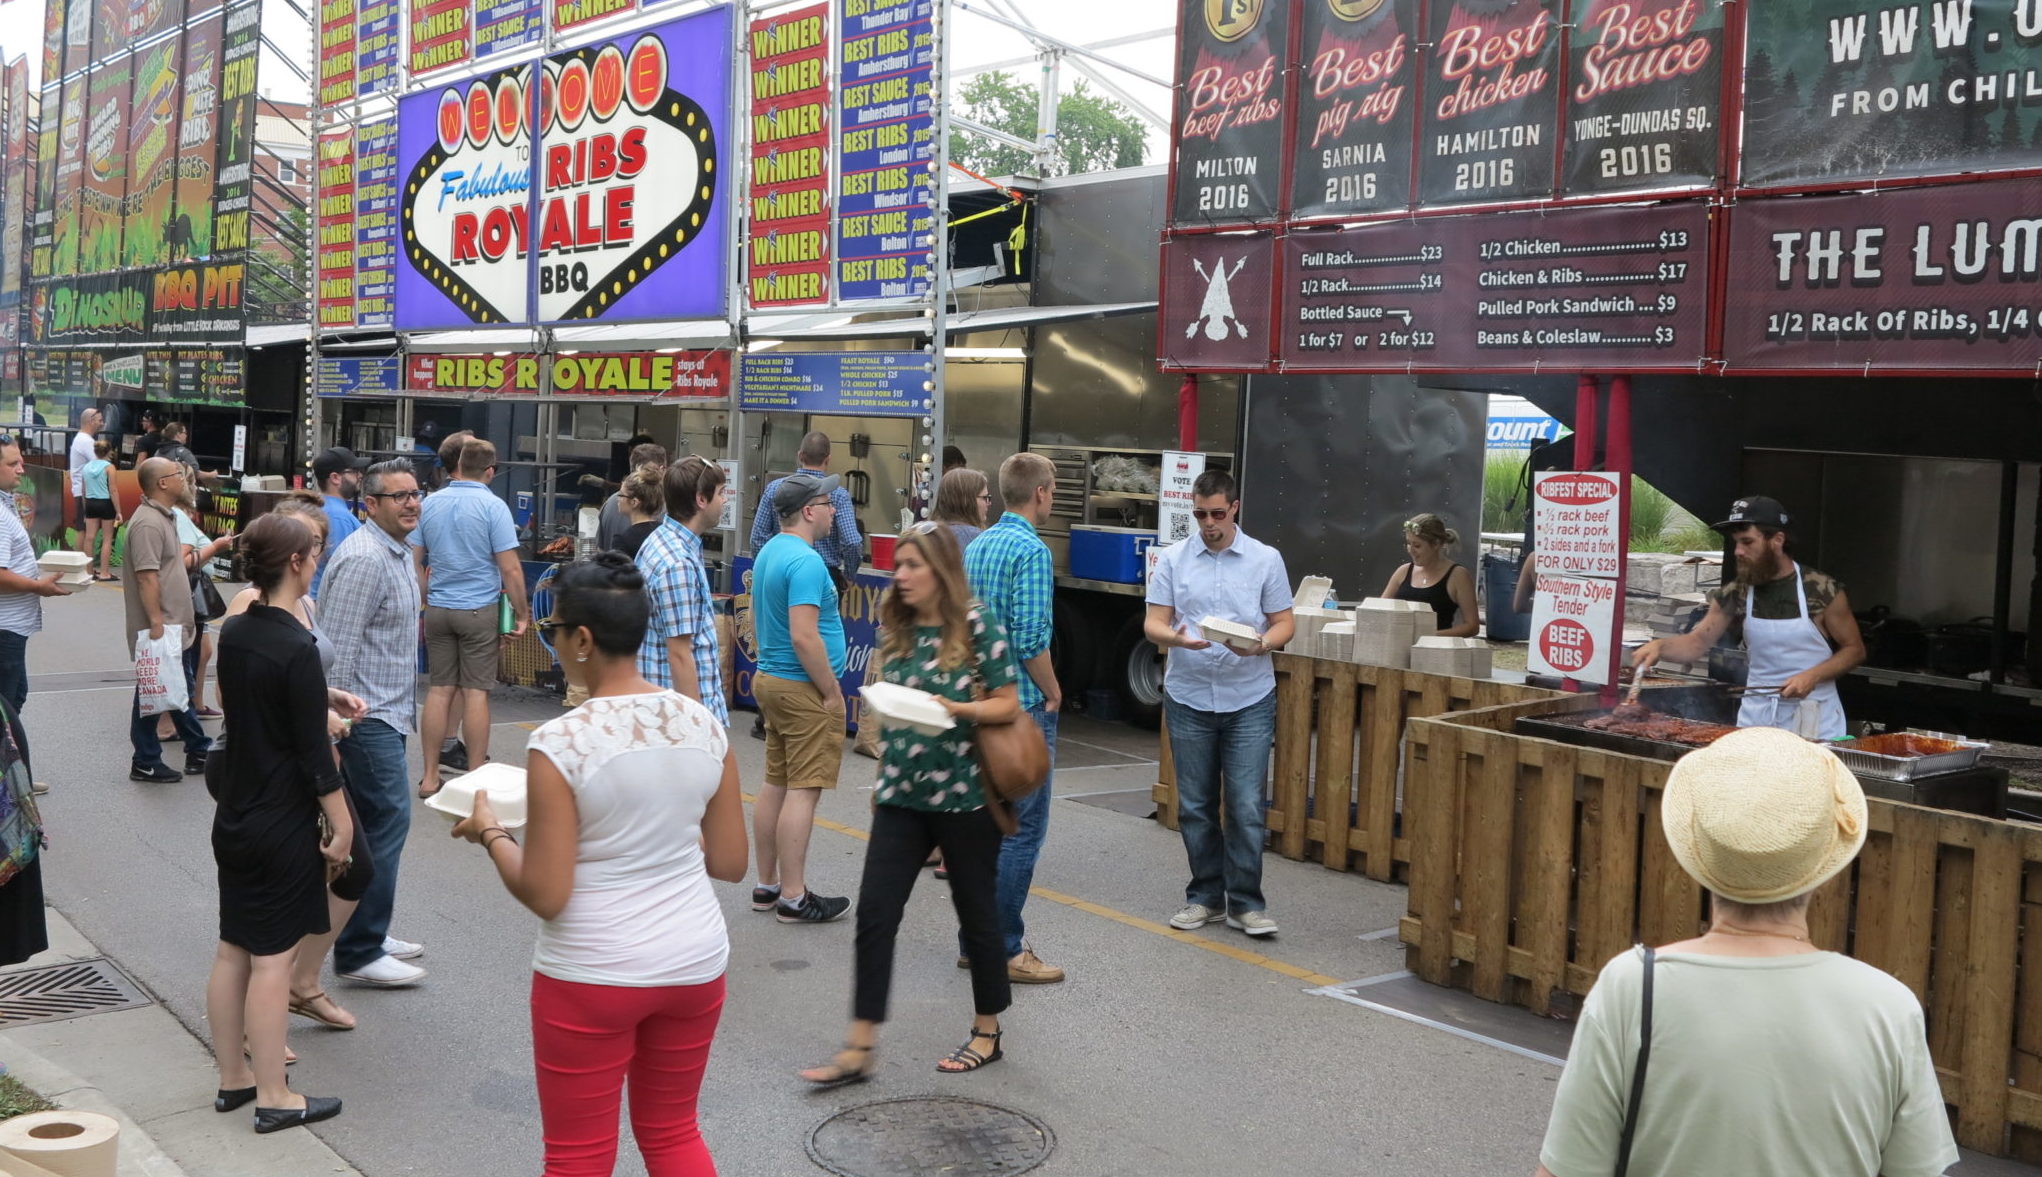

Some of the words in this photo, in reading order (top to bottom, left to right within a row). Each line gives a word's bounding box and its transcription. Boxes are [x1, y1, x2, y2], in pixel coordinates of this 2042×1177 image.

[413, 7, 463, 44] WINNER
[861, 11, 893, 30] Thunder
[894, 7, 909, 22] Bay
[1597, 0, 1696, 54] Best
[476, 25, 496, 46] BEST
[753, 16, 821, 60] WINNER
[844, 37, 875, 63] BEST
[877, 29, 909, 56] RIBS
[1438, 9, 1549, 80] Best
[412, 39, 463, 71] WINNER
[1309, 34, 1405, 99] Best
[753, 58, 821, 100] WINNER
[1187, 55, 1276, 110] Best
[1575, 37, 1711, 103] Sauce
[843, 84, 871, 109] BEST
[872, 77, 909, 104] SAUCE
[1436, 60, 1548, 121] chicken
[1830, 83, 1929, 118] FROM
[1948, 70, 2042, 105] CHIL
[754, 103, 821, 144] WINNER
[1183, 97, 1234, 140] beef
[1230, 92, 1280, 128] ribs
[1311, 97, 1353, 148] pig
[1351, 81, 1405, 125] rig
[1574, 108, 1680, 142] YONGE-DUNDAS
[1686, 106, 1712, 132] SQ.
[843, 129, 875, 154] BEST
[876, 123, 908, 148] RIBS
[1436, 124, 1541, 156] HAMILTON
[515, 145, 530, 162] TO
[546, 126, 649, 193] RIBS
[754, 147, 821, 186] WINNER
[880, 148, 909, 165] London
[1195, 156, 1258, 179] MILTON
[1322, 142, 1387, 169] SARNIA
[1600, 143, 1672, 178] 2016
[437, 162, 530, 213] Fabulous
[843, 172, 874, 196] BEST
[876, 167, 908, 192] RIBS
[1325, 173, 1377, 203] 2016
[1455, 158, 1514, 191] 2016
[753, 189, 820, 222] WINNER
[874, 192, 908, 208] Windsor
[1199, 184, 1249, 211] 2016
[450, 184, 636, 267] ROYALE
[842, 215, 870, 238] BEST
[871, 211, 907, 236] SAUCE
[753, 230, 820, 266] WINNER
[1301, 252, 1324, 266] Full
[1421, 245, 1443, 262] $23
[1480, 242, 1502, 259] 1/2
[1505, 240, 1561, 255] Chicken
[1659, 231, 1688, 249] $13
[1772, 227, 1884, 281] THE
[540, 261, 590, 295] BBQ
[842, 260, 874, 282] BEST
[876, 257, 907, 280] RIBS
[1301, 280, 1319, 295] 1/2
[1420, 273, 1442, 290] $14
[1479, 270, 1534, 286] Chicken
[1537, 270, 1549, 284] &
[1551, 268, 1583, 284] Ribs
[1658, 263, 1687, 281] $17
[153, 269, 197, 313] BBQ
[202, 265, 243, 310] PIT
[753, 272, 820, 302] WINNER
[1300, 305, 1345, 320] Bottled
[1347, 306, 1383, 319] Sauce
[1478, 300, 1523, 315] Pulled
[1526, 302, 1560, 315] Pork
[1563, 296, 1635, 313] Sandwich
[1657, 293, 1677, 313] $9
[1477, 330, 1519, 345] Beans
[1522, 330, 1534, 344] &
[1655, 326, 1674, 345] $3
[1768, 313, 1804, 335] 1/2
[1811, 311, 1868, 333] Rack
[1877, 311, 1906, 332] Of
[1913, 309, 1978, 335] Ribs,
[1987, 307, 2029, 334] 1/4
[1299, 334, 1306, 347] 1
[1309, 333, 1327, 346] for
[1328, 332, 1343, 348] $7
[1354, 335, 1368, 346] or
[1379, 333, 1387, 346] 2
[1390, 332, 1409, 346] for
[1412, 330, 1435, 347] $12
[436, 358, 505, 388] RIBS
[677, 360, 695, 372] stays
[696, 359, 706, 371] at
[677, 374, 692, 387] Ribs
[693, 373, 719, 390] Royale
[1163, 491, 1180, 499] BEST
[1173, 477, 1192, 486] VOTE
[1541, 482, 1575, 497] RIBFEST
[1577, 482, 1613, 498] SPECIAL
[1557, 509, 1582, 521] rack
[1584, 509, 1610, 522] beef
[1544, 537, 1549, 551] 2
[1550, 537, 1572, 552] sides
[1573, 538, 1590, 552] and
[1591, 543, 1596, 552] a
[1599, 539, 1616, 553] fork
[1556, 524, 1581, 535] rack
[1583, 525, 1609, 538] pork
[1537, 555, 1560, 568] FOR
[1563, 556, 1594, 570] ONLY
[1597, 558, 1617, 572] $29
[1536, 574, 1581, 597] Southern
[1583, 580, 1613, 603] Style
[1553, 595, 1588, 616] Tender
[1548, 624, 1586, 646] BEEF
[1548, 645, 1583, 668] RIBS
